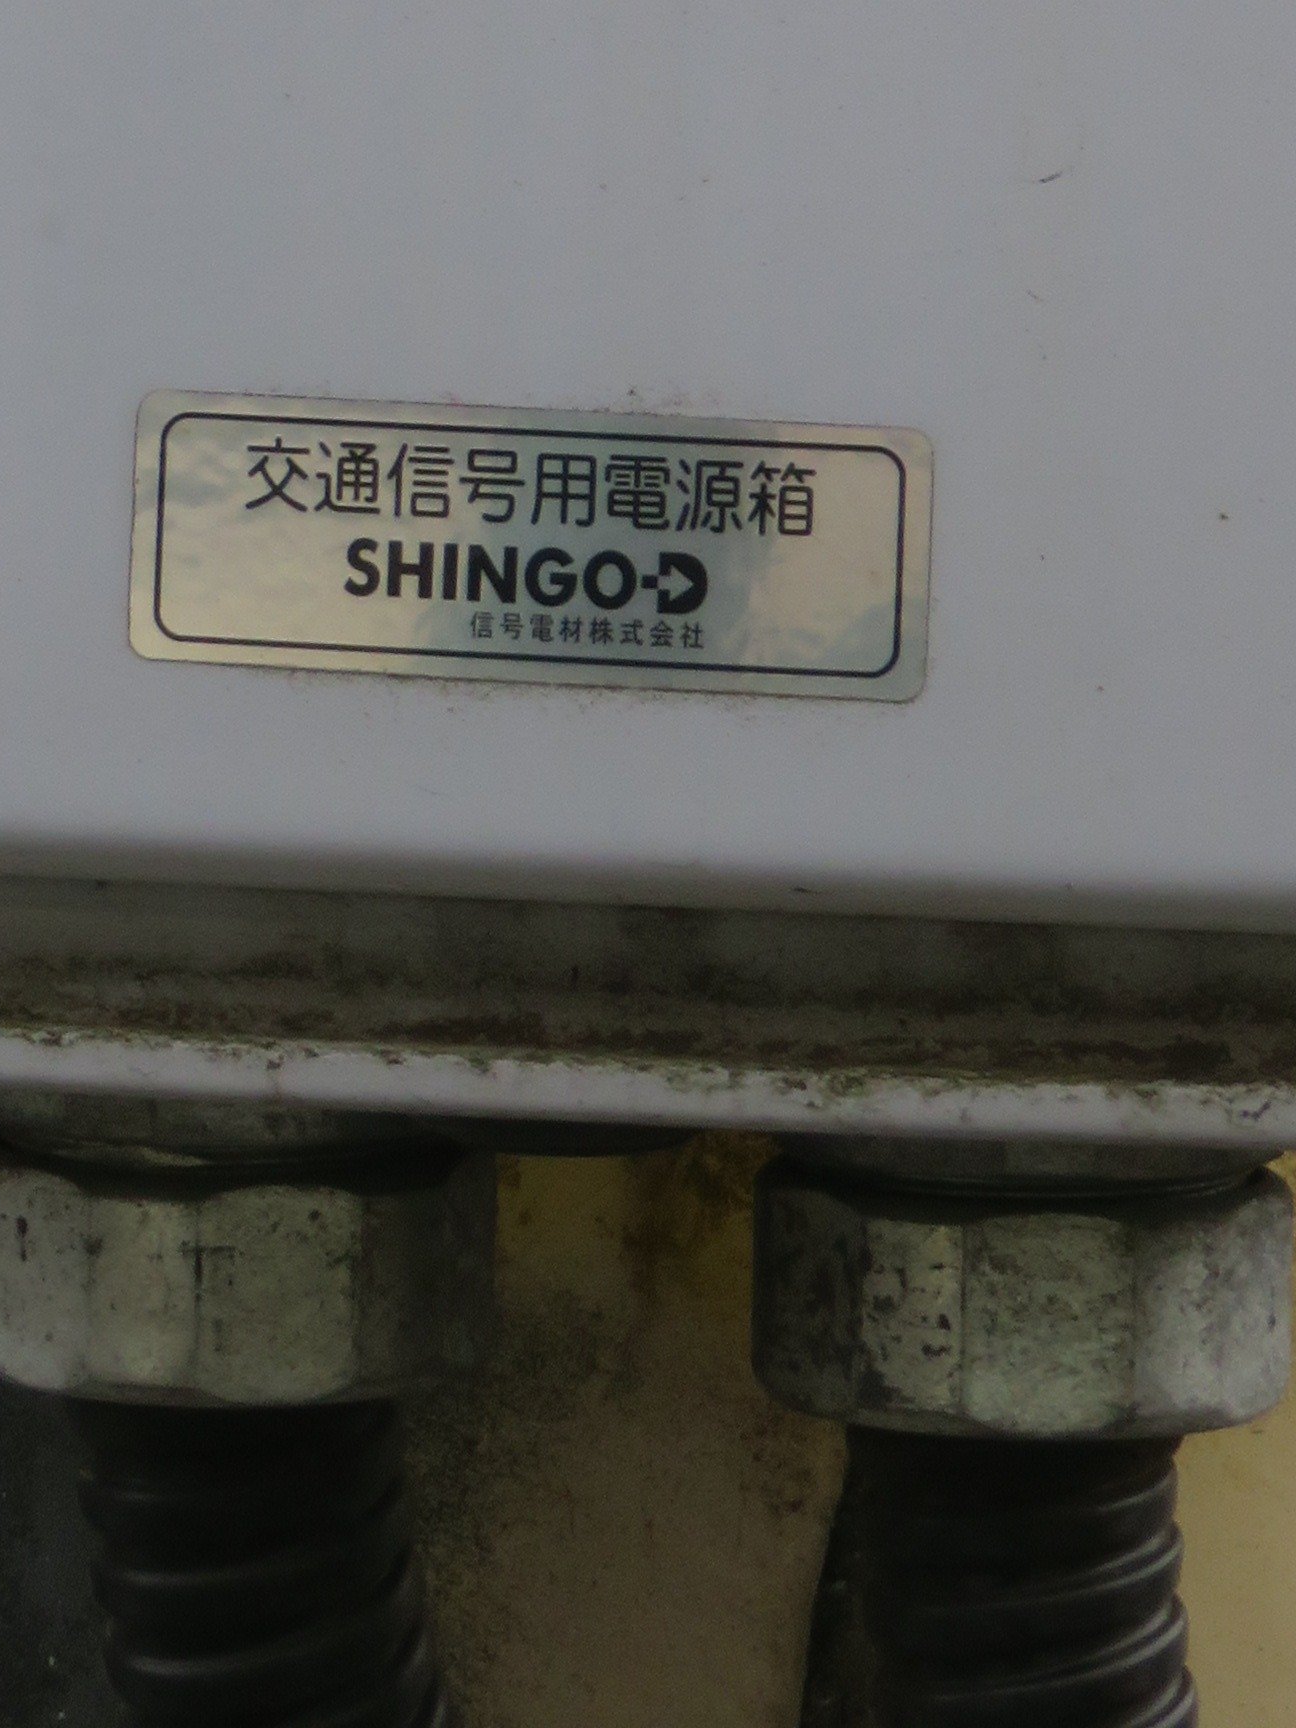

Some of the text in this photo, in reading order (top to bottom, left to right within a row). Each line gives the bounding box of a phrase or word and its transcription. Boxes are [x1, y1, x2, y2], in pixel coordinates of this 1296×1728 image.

[245, 436, 817, 537] 交通信号用電源箱
[470, 611, 705, 649] 信号電材株式会社
